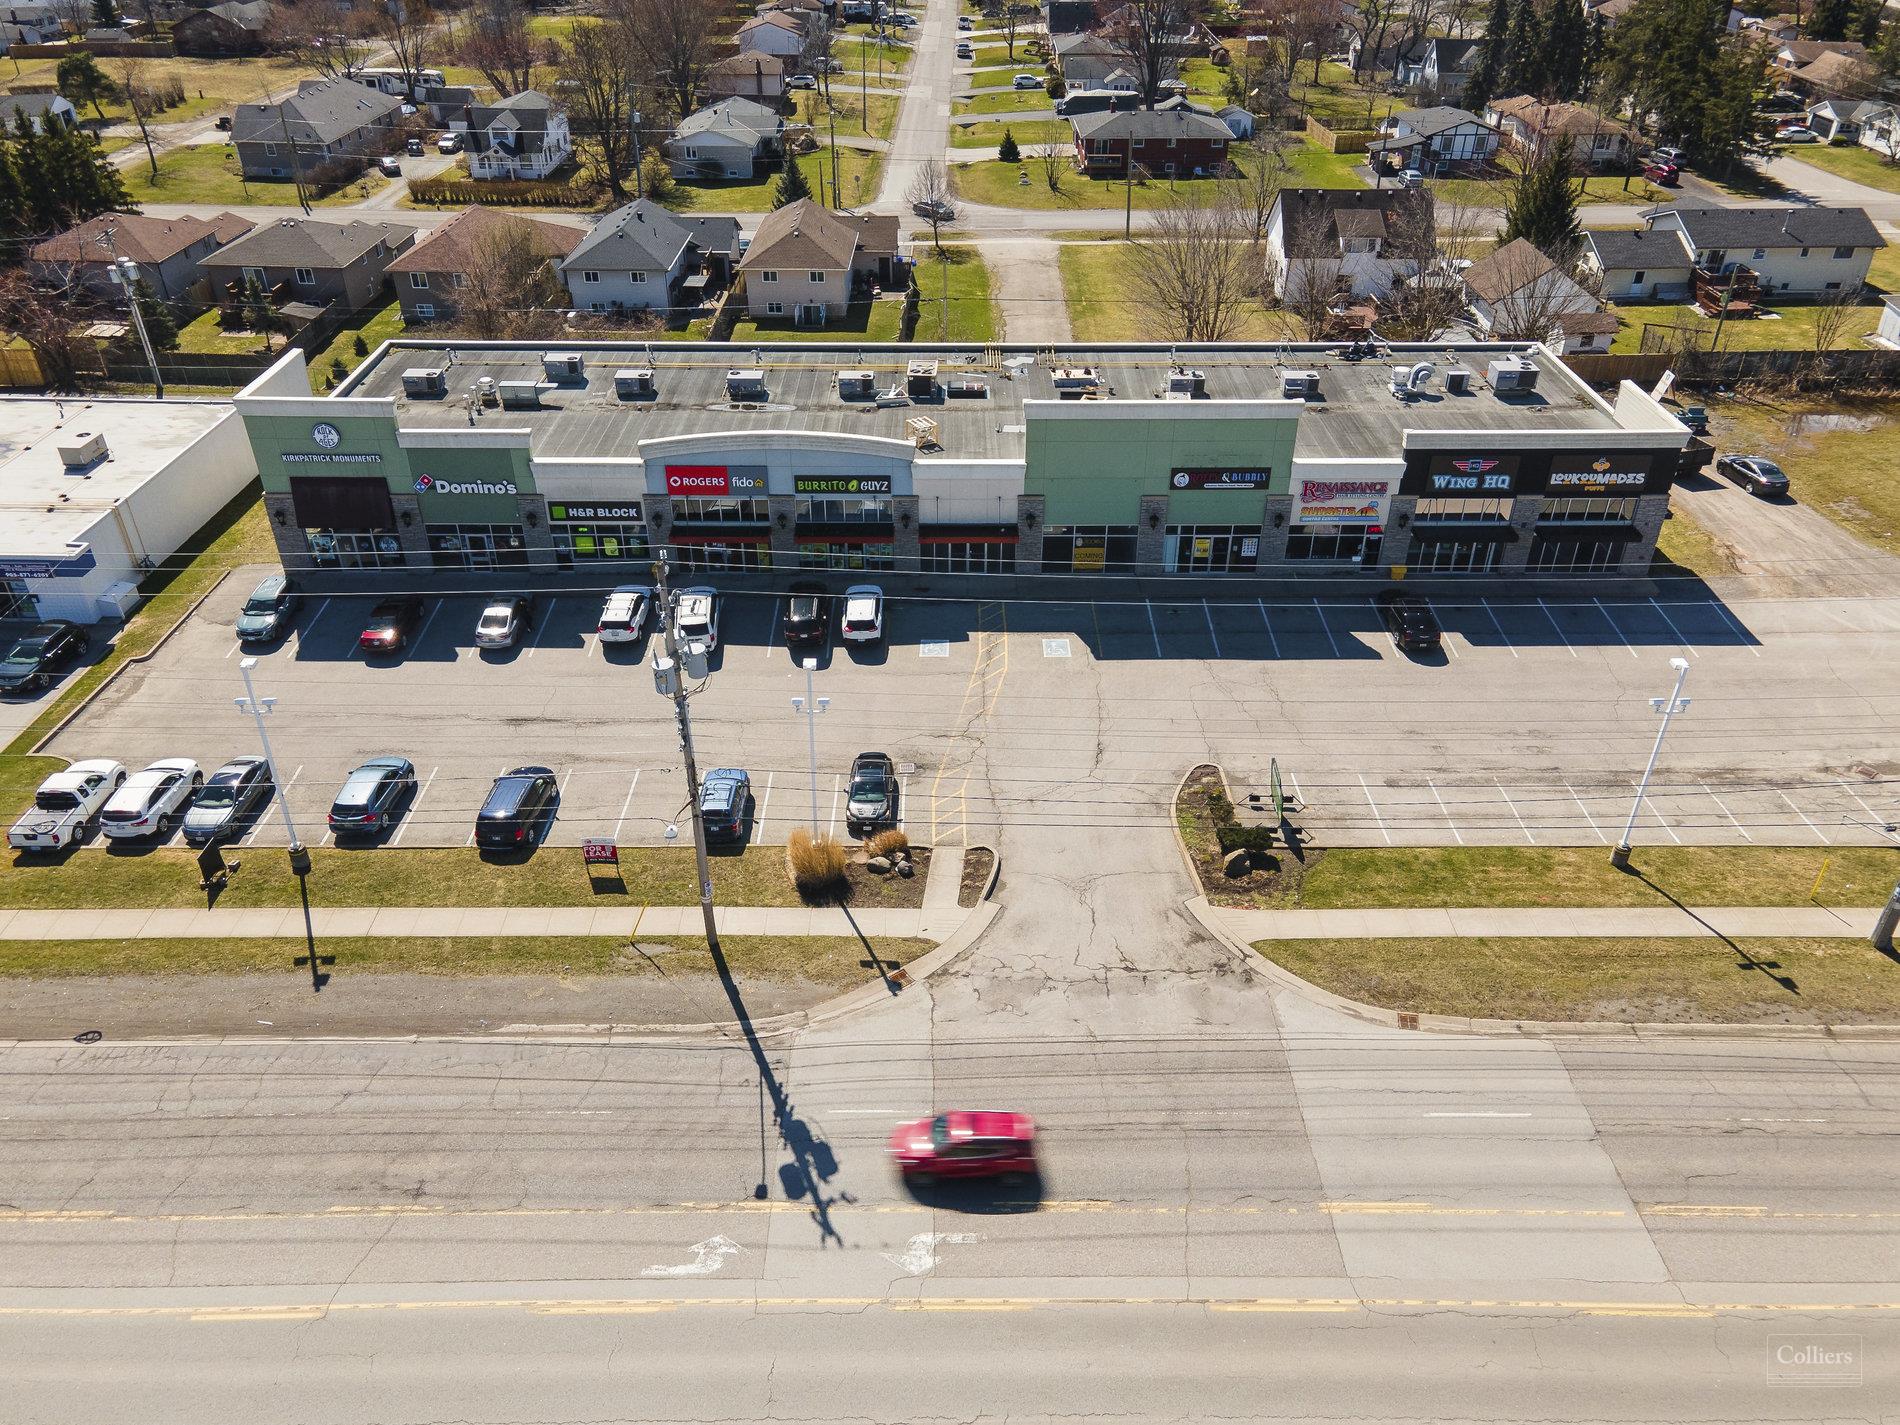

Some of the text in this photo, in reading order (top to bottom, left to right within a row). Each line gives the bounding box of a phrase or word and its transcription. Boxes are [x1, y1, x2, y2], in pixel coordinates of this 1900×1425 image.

[281, 454, 381, 463] KIRKPATRICK MONUMENTS
[1232, 472, 1268, 481] BUBBLY
[1433, 474, 1511, 489] WING HQ
[435, 479, 518, 494] Domino's
[683, 477, 753, 487] ROGERS fido
[797, 481, 889, 491] BURRITO GUYZ
[1301, 480, 1388, 501] RENAISSANCE
[568, 508, 638, 517] H&R BLOCK
